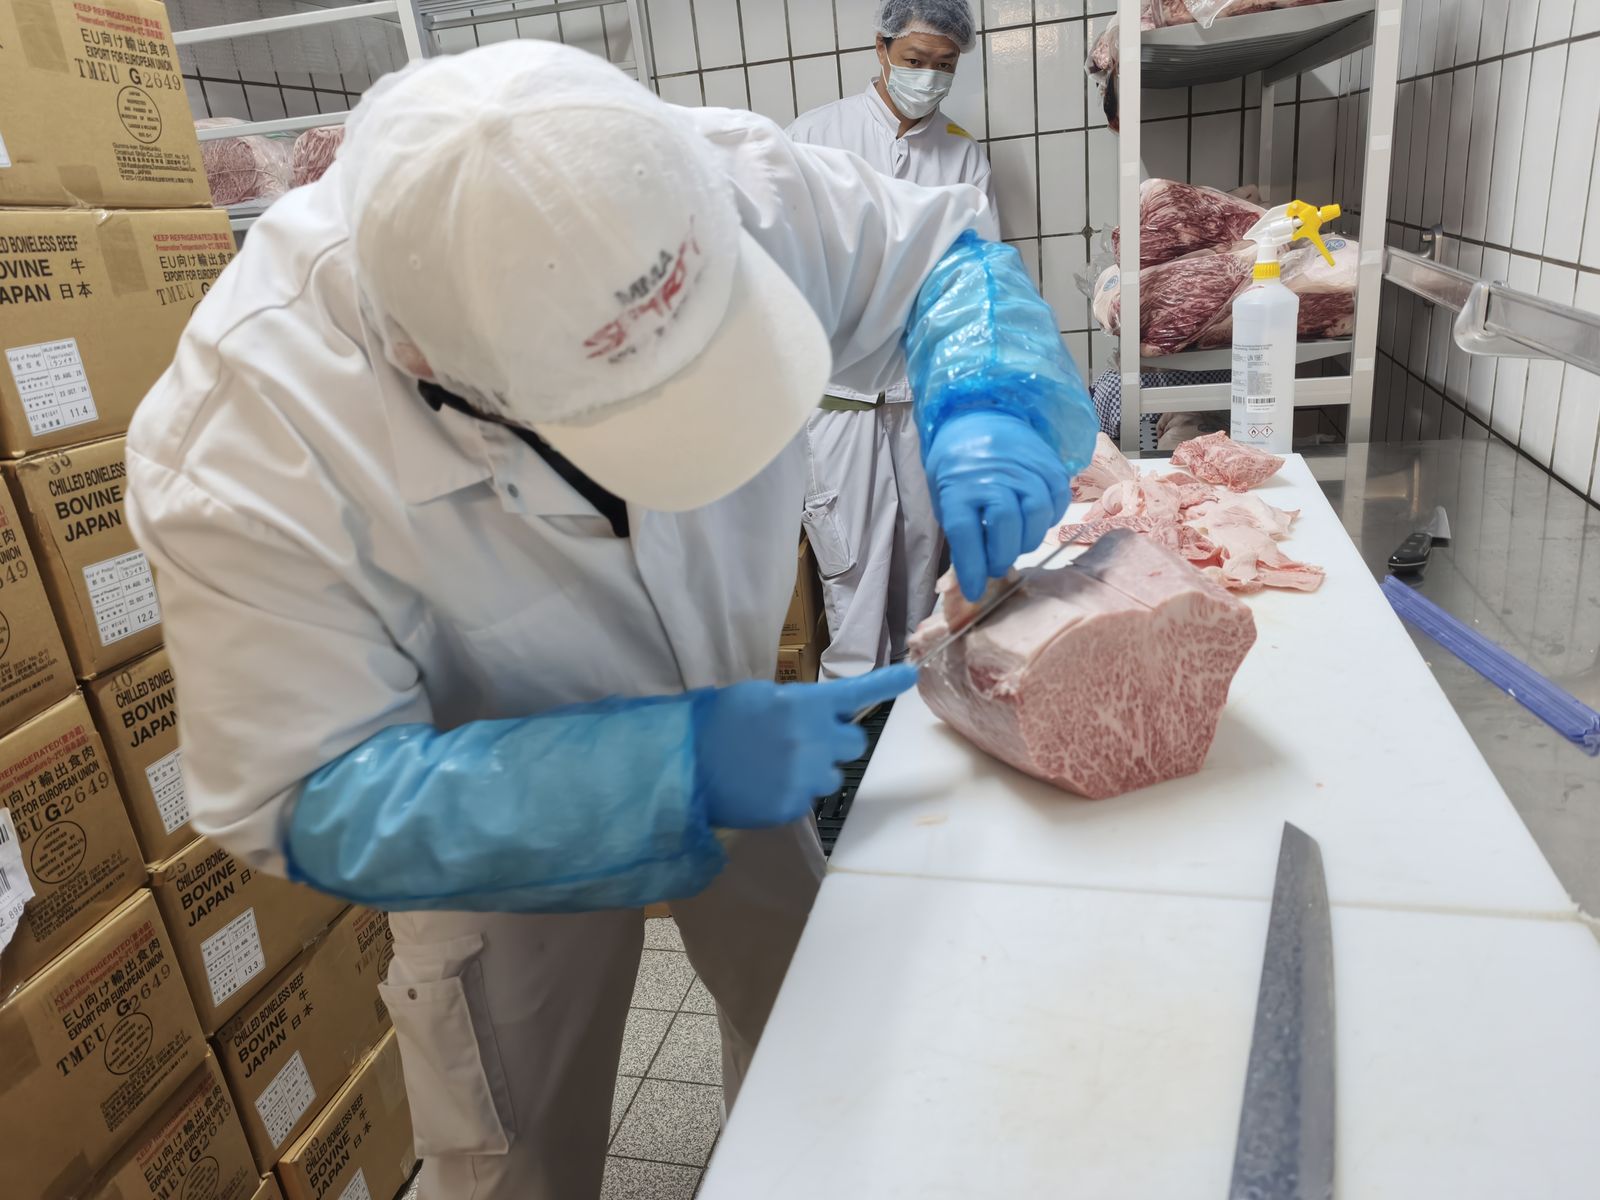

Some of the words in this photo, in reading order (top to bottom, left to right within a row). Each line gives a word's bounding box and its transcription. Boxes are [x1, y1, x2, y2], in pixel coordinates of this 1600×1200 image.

[81, 27, 170, 58] EU向け輸出食肉
[85, 45, 110, 61] EXPORT
[111, 51, 124, 64] FOR
[124, 53, 156, 69] EUROPEAN
[155, 59, 173, 71] UNION
[74, 58, 120, 84] TMEU
[8, 235, 57, 253] BONELESS
[56, 235, 78, 251] BEEF
[71, 258, 86, 275] 牛
[163, 270, 185, 282] EXPORT
[185, 270, 197, 280] FOR
[59, 281, 93, 299] 日本
[156, 282, 195, 306] TMEU
[70, 405, 88, 418] 11.4
[48, 473, 85, 497] CHILLED
[85, 461, 126, 487] BONELESS
[55, 485, 123, 520] BOVINE
[65, 509, 122, 542] JAPAN
[116, 681, 149, 709] CHILLED
[122, 687, 177, 729] BOVIN
[22, 798, 39, 816] FOR
[38, 774, 78, 807] EUROPEAN
[77, 760, 100, 781] UNION
[176, 862, 205, 892] CHILLED
[181, 859, 237, 910] BOVINE
[189, 881, 234, 927] JAPAN
[240, 868, 257, 885] 日
[62, 937, 161, 1029] EU向け輸出食肉
[68, 1011, 97, 1041] EXPORT
[96, 997, 112, 1016] FOR
[110, 972, 146, 1004] EUROPEAN
[145, 951, 164, 976] UNION
[234, 1016, 261, 1047] CHILLED
[260, 987, 291, 1023] BONELESS
[289, 972, 304, 994] BEEF
[238, 1007, 288, 1064] BOVINE
[298, 988, 309, 1001] 牛
[56, 1023, 107, 1077] TMEU
[245, 1028, 287, 1079] JAPAN
[291, 1002, 314, 1031] 日本
[149, 1162, 172, 1192] EXPORT
[172, 1147, 185, 1166] FOR
[183, 1114, 212, 1152] EUROPEAN
[210, 1098, 226, 1120] UNION
[305, 1142, 328, 1174] CHILLED
[327, 1110, 353, 1148] BONELESS
[351, 1093, 363, 1114] BEEF
[309, 1129, 351, 1188] BOVINE
[359, 1108, 368, 1120] 牛
[316, 1150, 351, 1200] JAPAN
[353, 1120, 372, 1149] 日本
